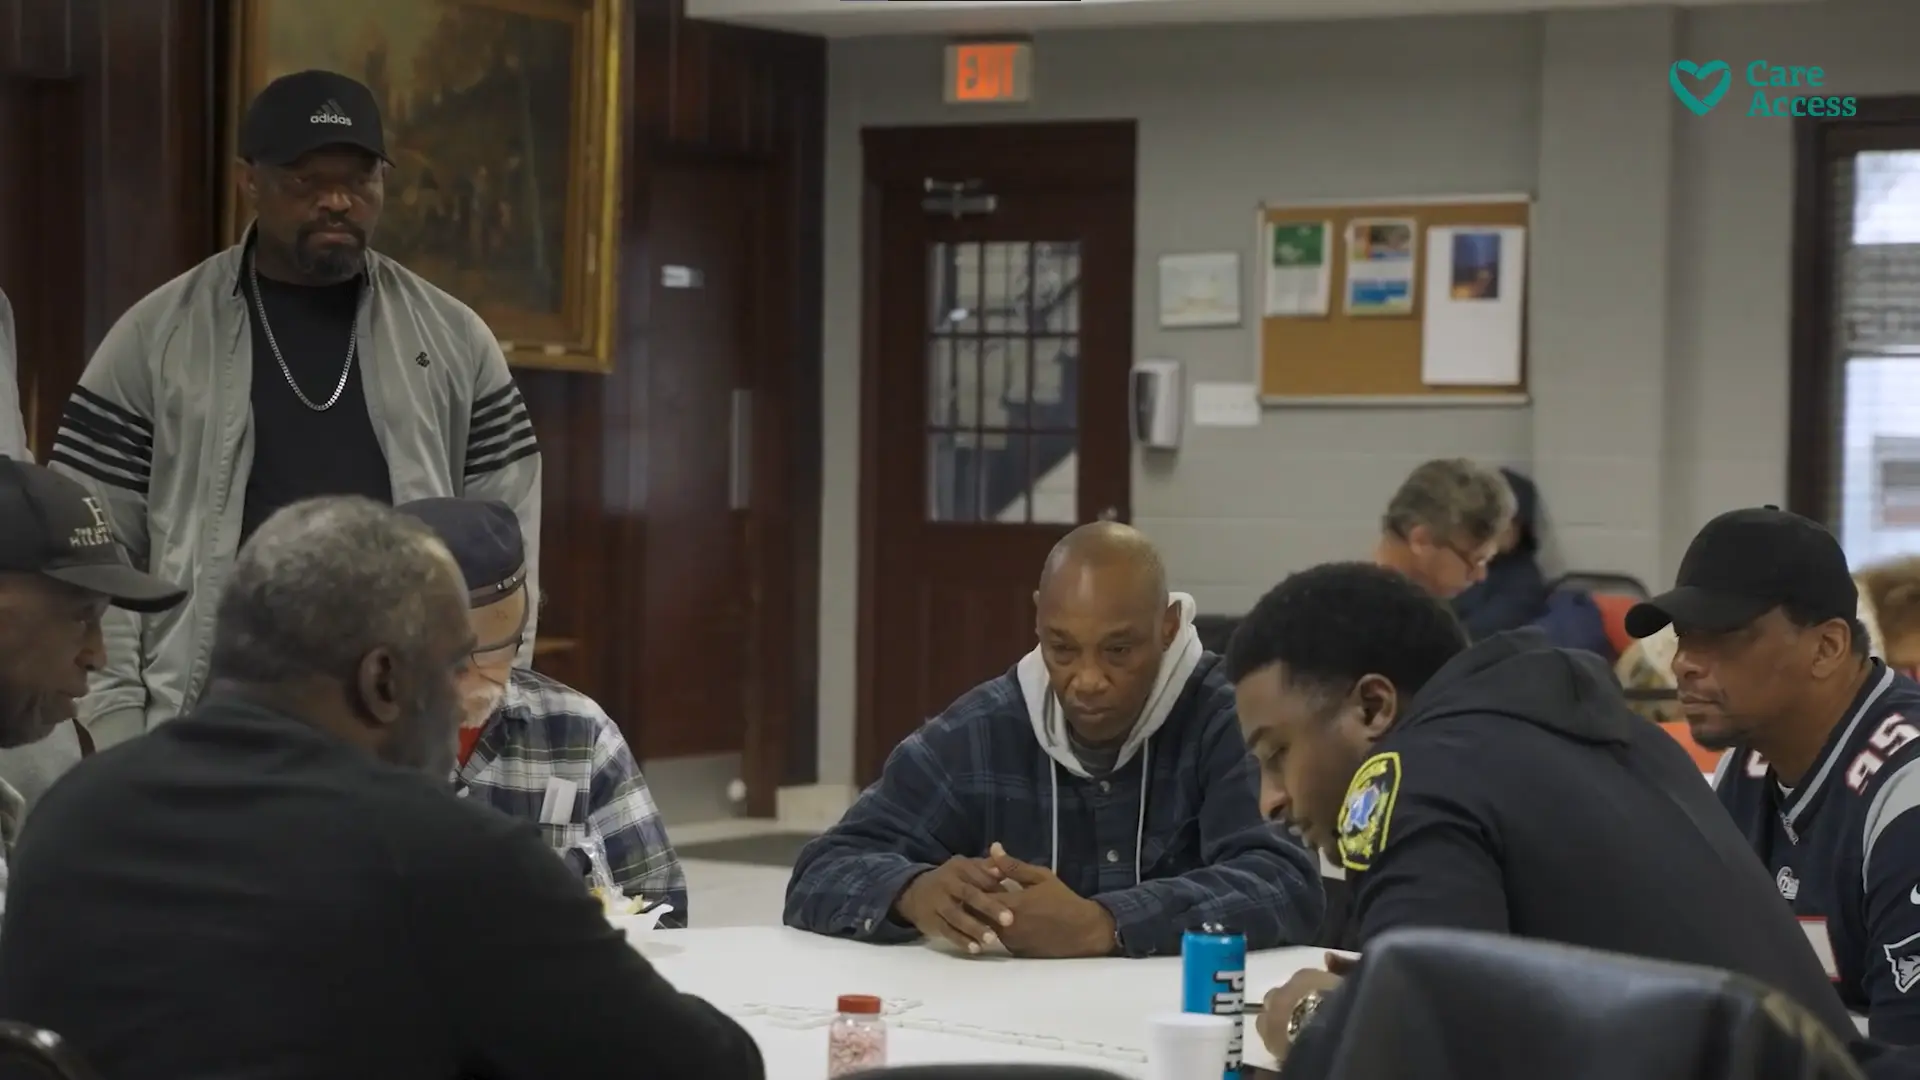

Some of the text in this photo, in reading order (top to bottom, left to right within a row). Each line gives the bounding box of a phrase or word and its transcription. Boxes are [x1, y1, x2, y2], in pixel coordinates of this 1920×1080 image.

[957, 44, 1018, 99] EXIT
[310, 113, 352, 126] adidas
[1845, 712, 1920, 796] 95
